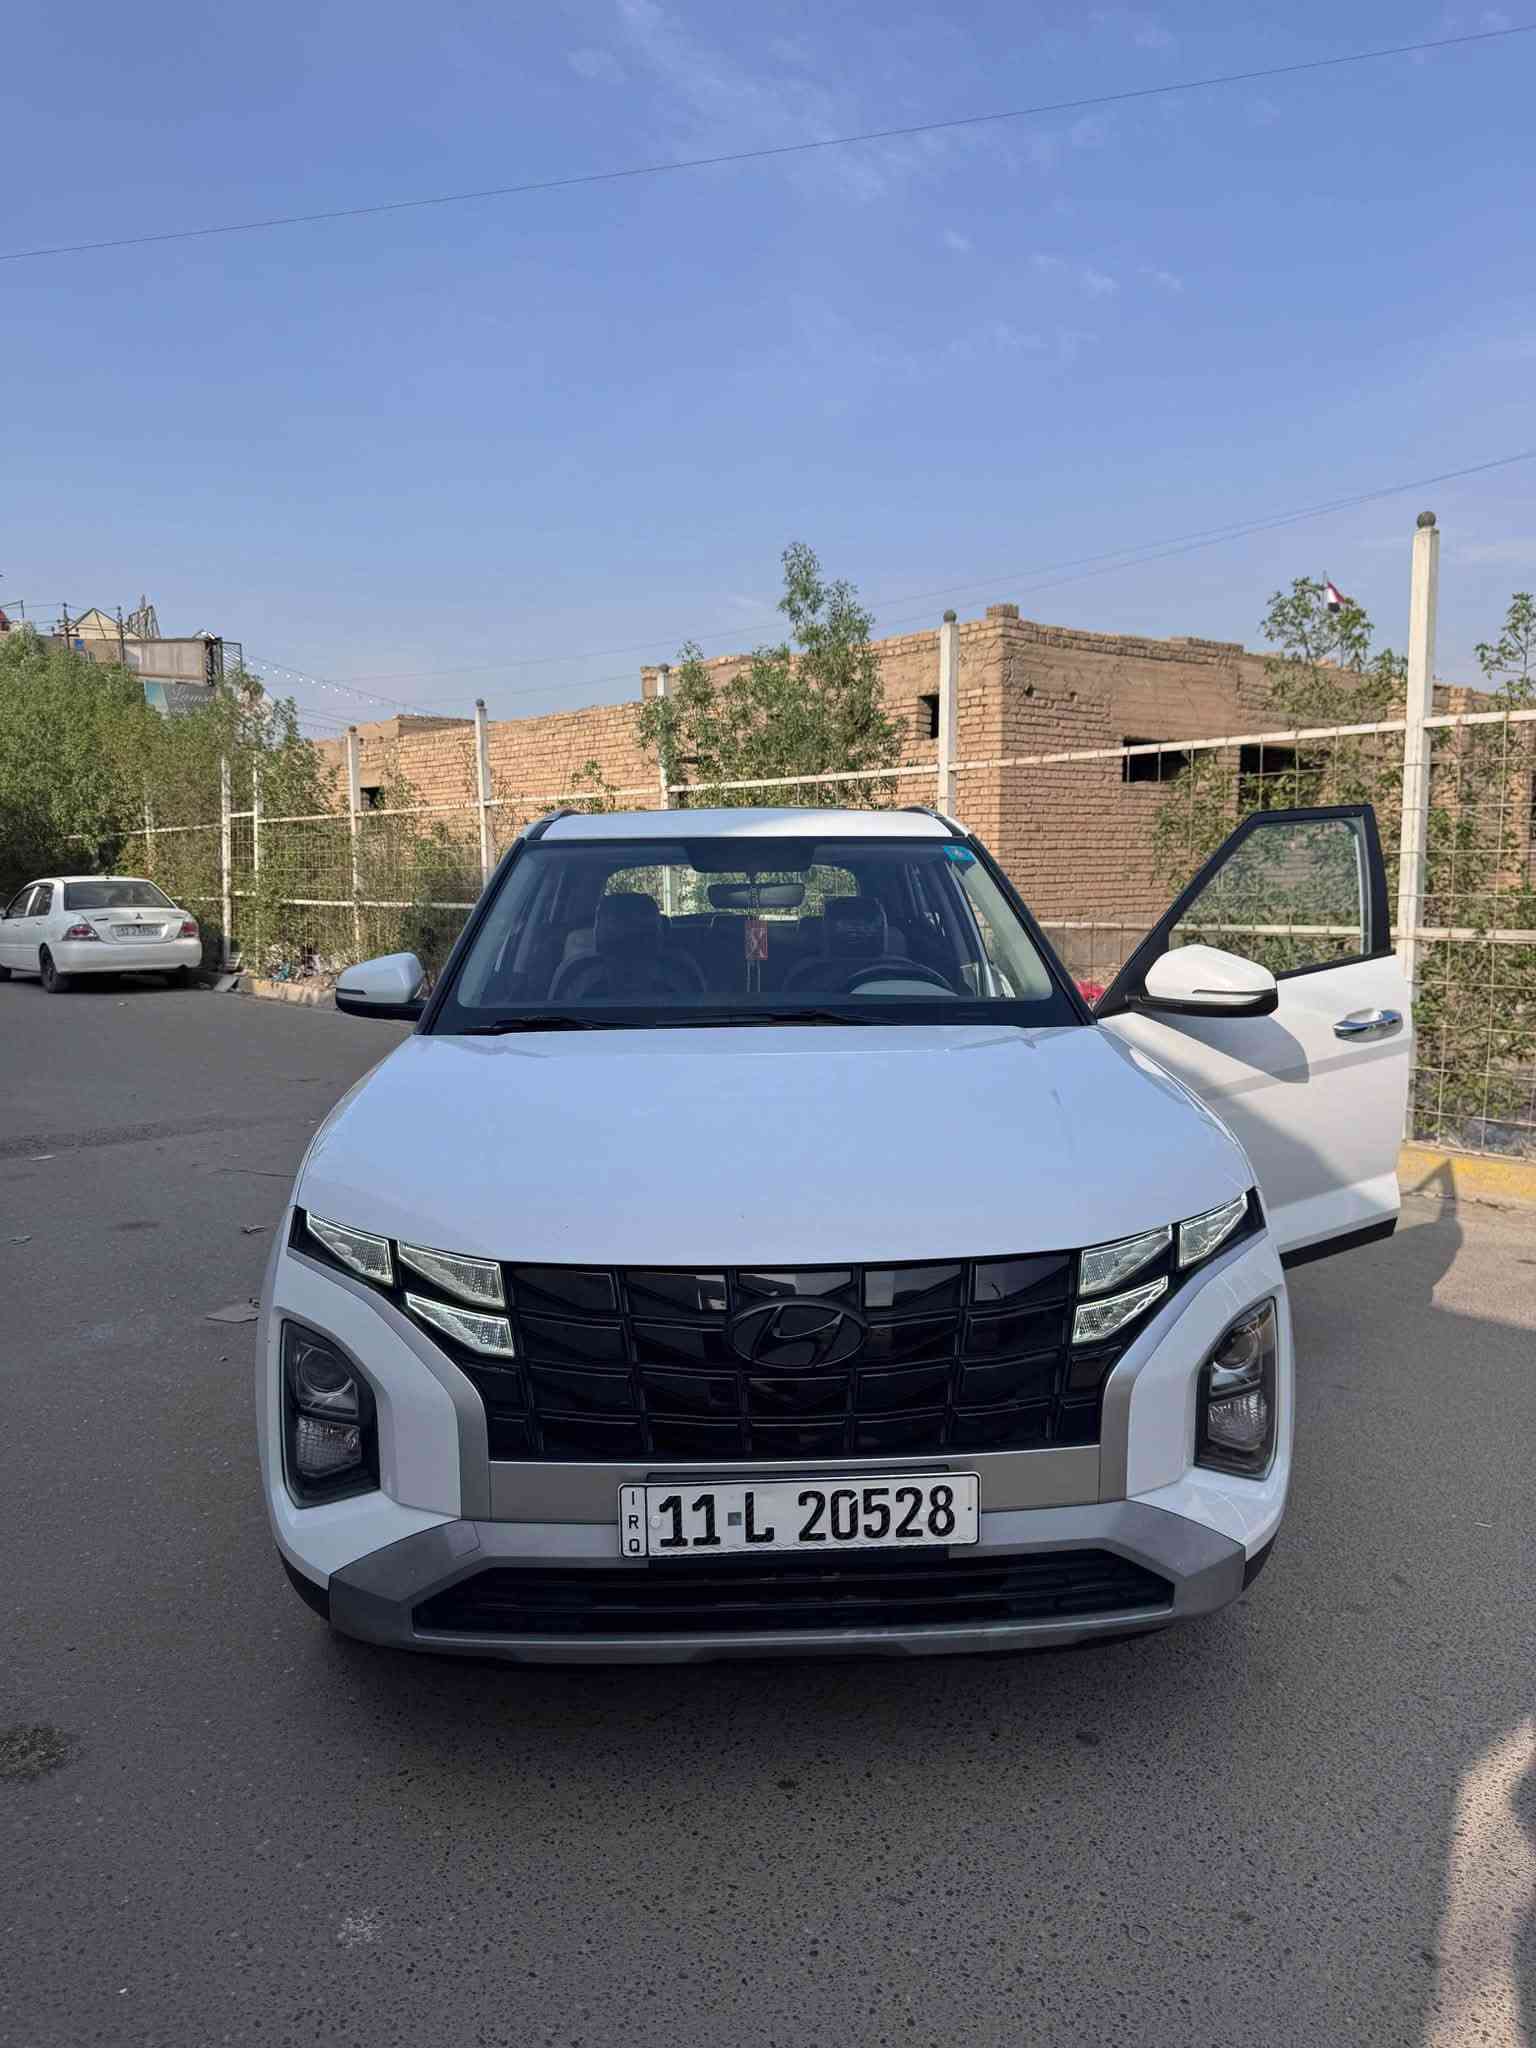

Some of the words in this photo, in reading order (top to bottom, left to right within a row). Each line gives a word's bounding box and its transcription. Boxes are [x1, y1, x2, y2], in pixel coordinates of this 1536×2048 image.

[628, 1490, 640, 1553] IRQ
[658, 1494, 721, 1548] 11
[797, 1484, 956, 1542] 20528
